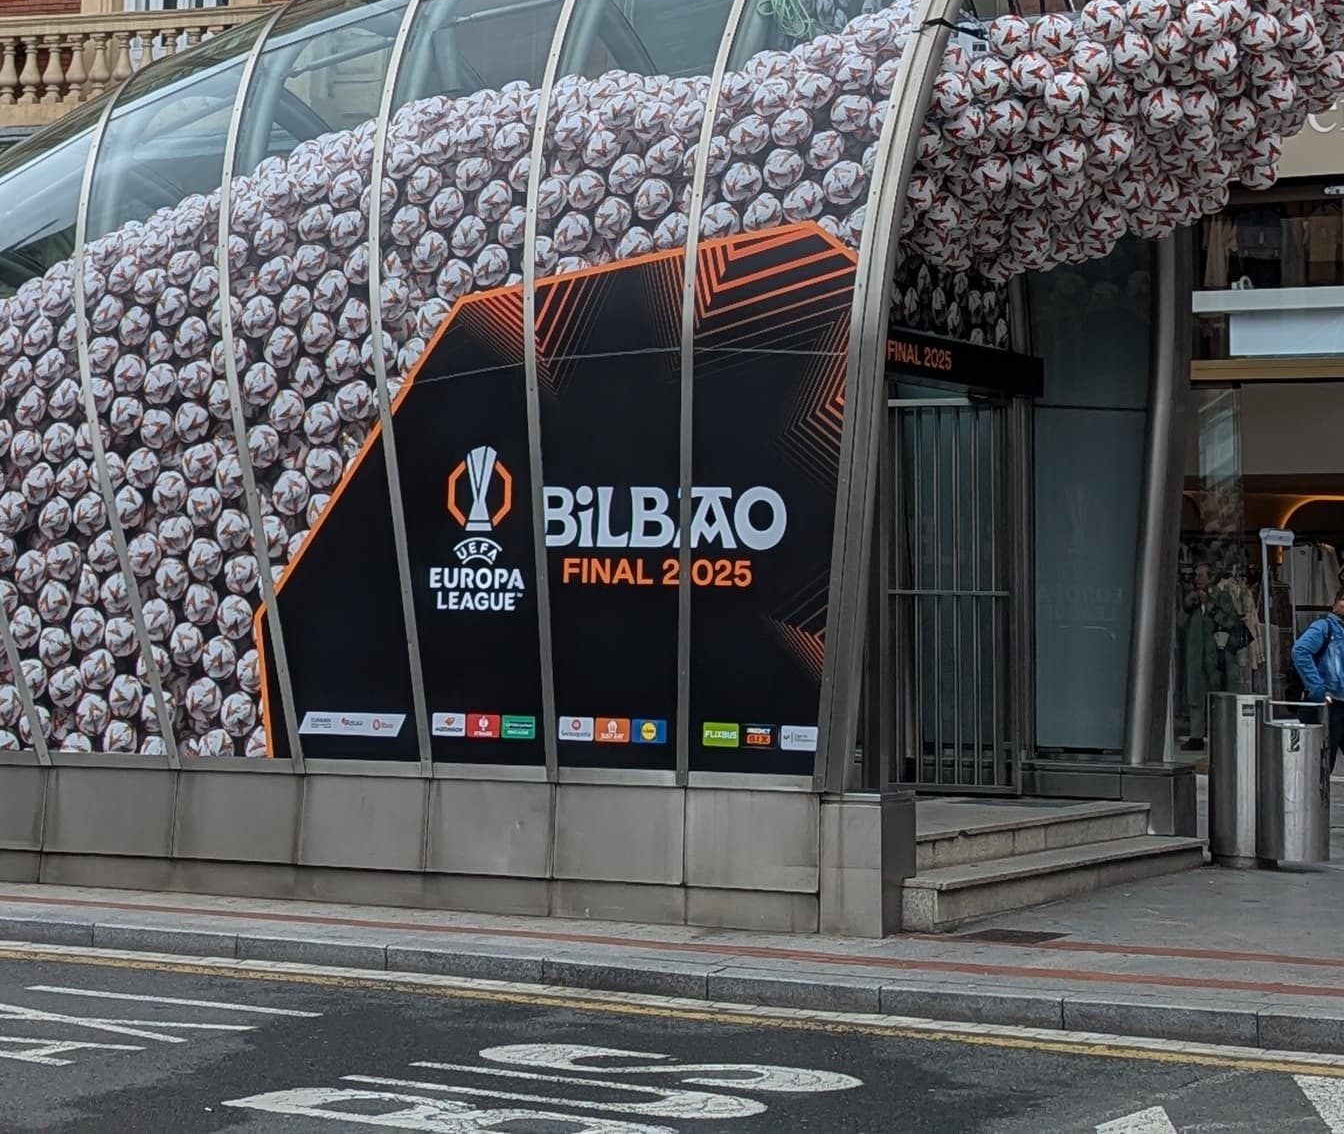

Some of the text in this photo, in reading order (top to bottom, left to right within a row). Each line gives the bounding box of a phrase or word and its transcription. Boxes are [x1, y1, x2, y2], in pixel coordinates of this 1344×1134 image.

[887, 339, 952, 370] FINAL 2025
[455, 539, 501, 563] UEFA
[429, 567, 526, 590] EUROPA
[562, 557, 753, 587] FINAL 2025
[704, 729, 737, 740] FLIXBUS
